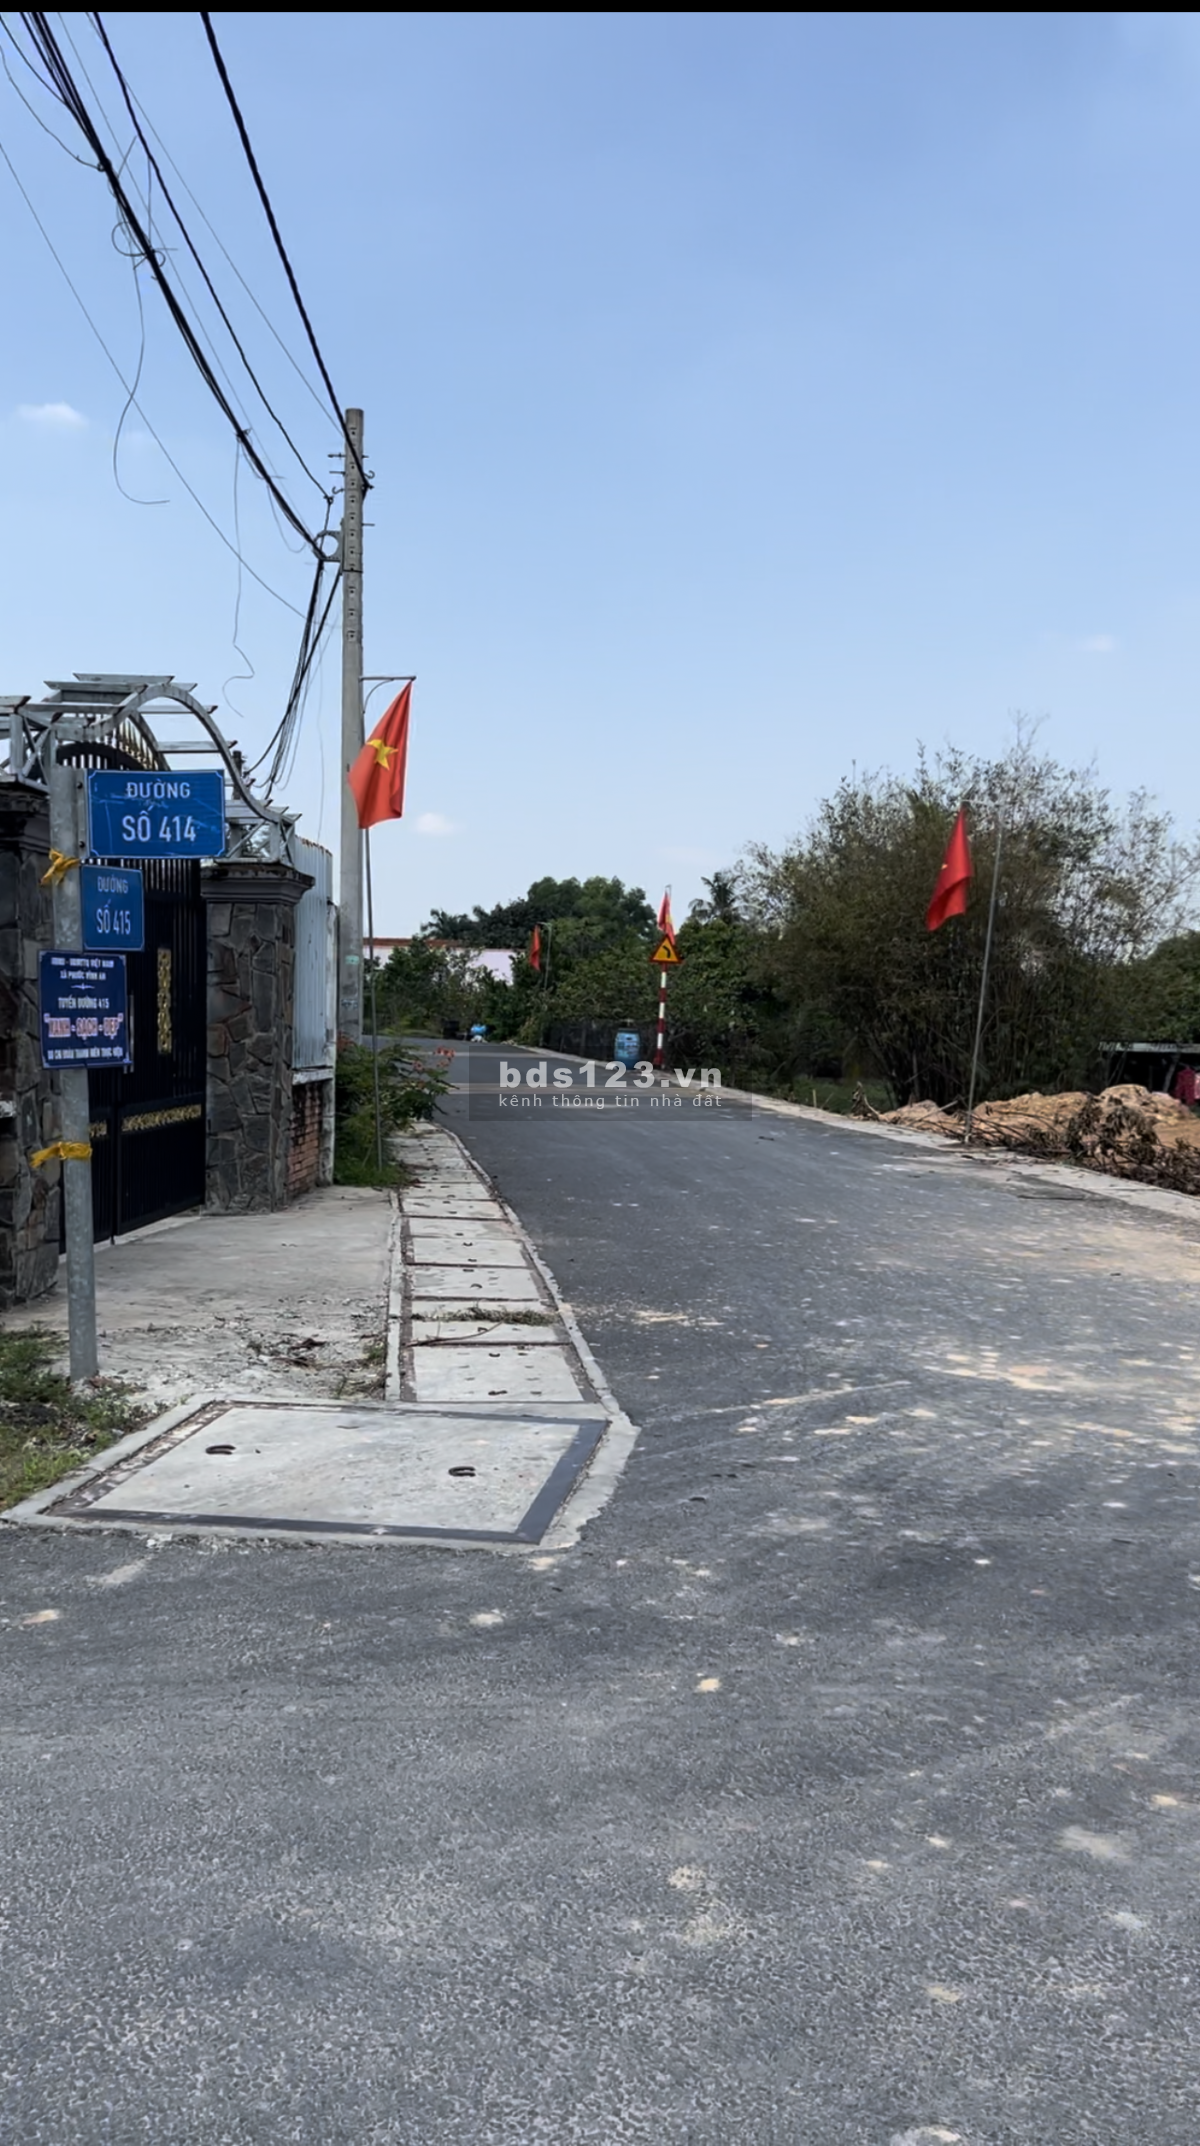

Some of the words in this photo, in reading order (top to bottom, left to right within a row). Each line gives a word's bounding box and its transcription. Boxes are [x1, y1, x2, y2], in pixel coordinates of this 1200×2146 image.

[126, 778, 191, 799] ĐƯỜNG
[122, 804, 154, 842] SỐ
[159, 816, 197, 842] 414
[97, 874, 129, 894] ĐƯỜNG
[96, 898, 111, 934] SỐ
[113, 910, 131, 935] 415
[58, 993, 77, 1010] TUYẾN
[98, 997, 110, 1010] 415
